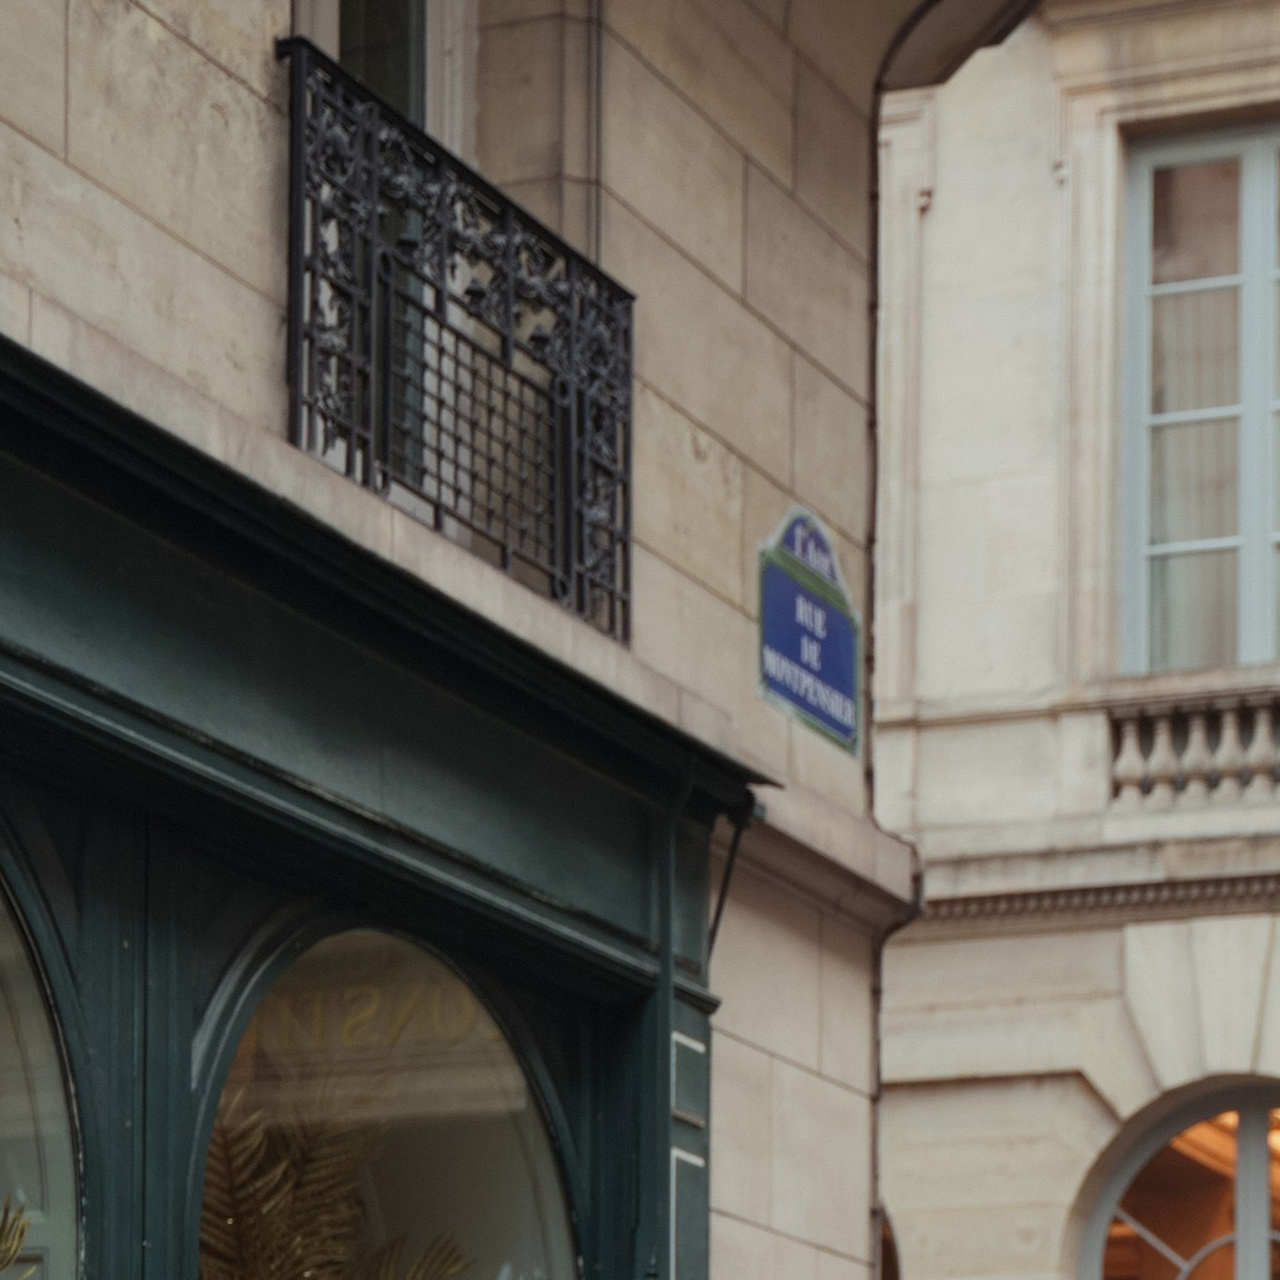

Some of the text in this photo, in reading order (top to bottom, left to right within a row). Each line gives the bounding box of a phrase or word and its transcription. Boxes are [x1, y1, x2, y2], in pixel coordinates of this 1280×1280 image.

[795, 594, 827, 640] RUE
[800, 634, 822, 671] DE
[763, 644, 856, 727] MONTPENSIER
